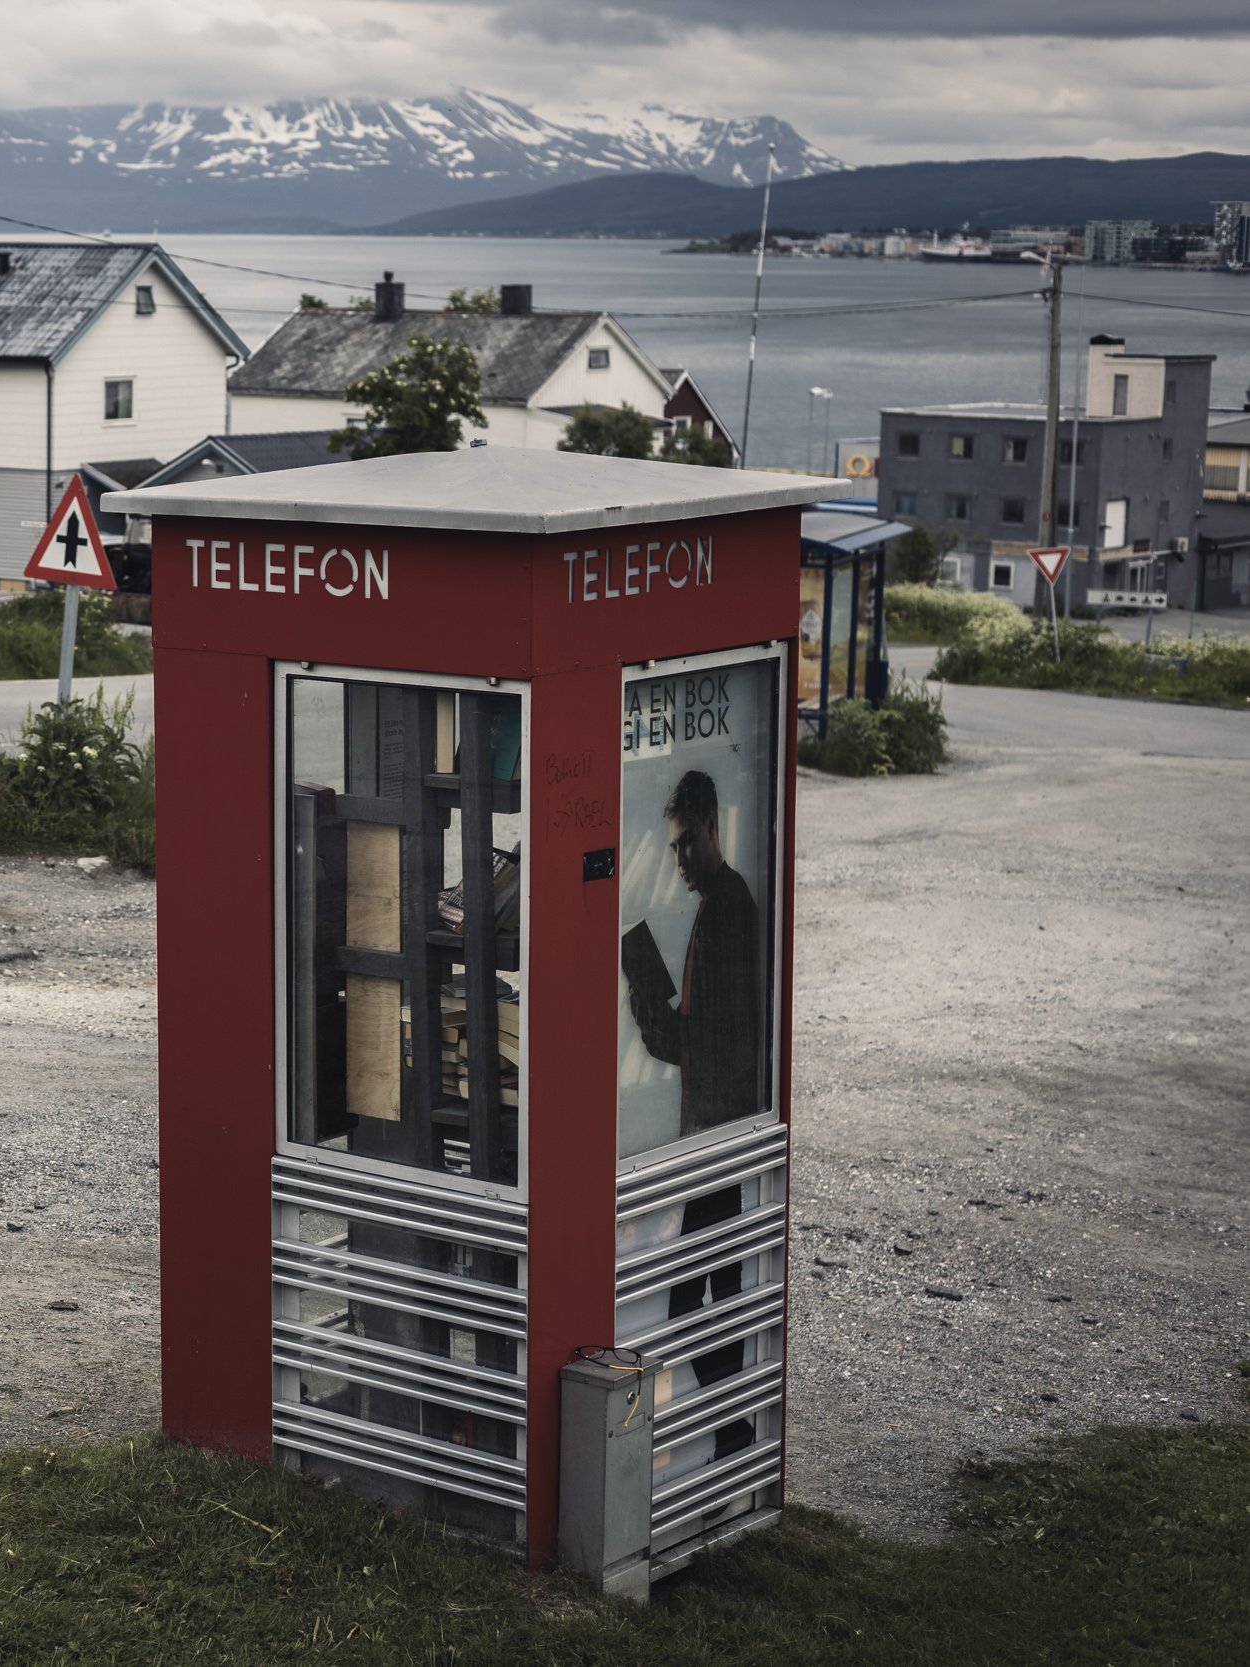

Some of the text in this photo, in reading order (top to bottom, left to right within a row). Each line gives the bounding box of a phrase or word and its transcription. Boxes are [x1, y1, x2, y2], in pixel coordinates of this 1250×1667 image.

[185, 538, 389, 600] TELEFON
[563, 535, 714, 604] TELEFON
[650, 681, 676, 713] EN
[685, 674, 730, 709] BOK
[649, 713, 676, 744] EN
[684, 705, 730, 742] BOK
